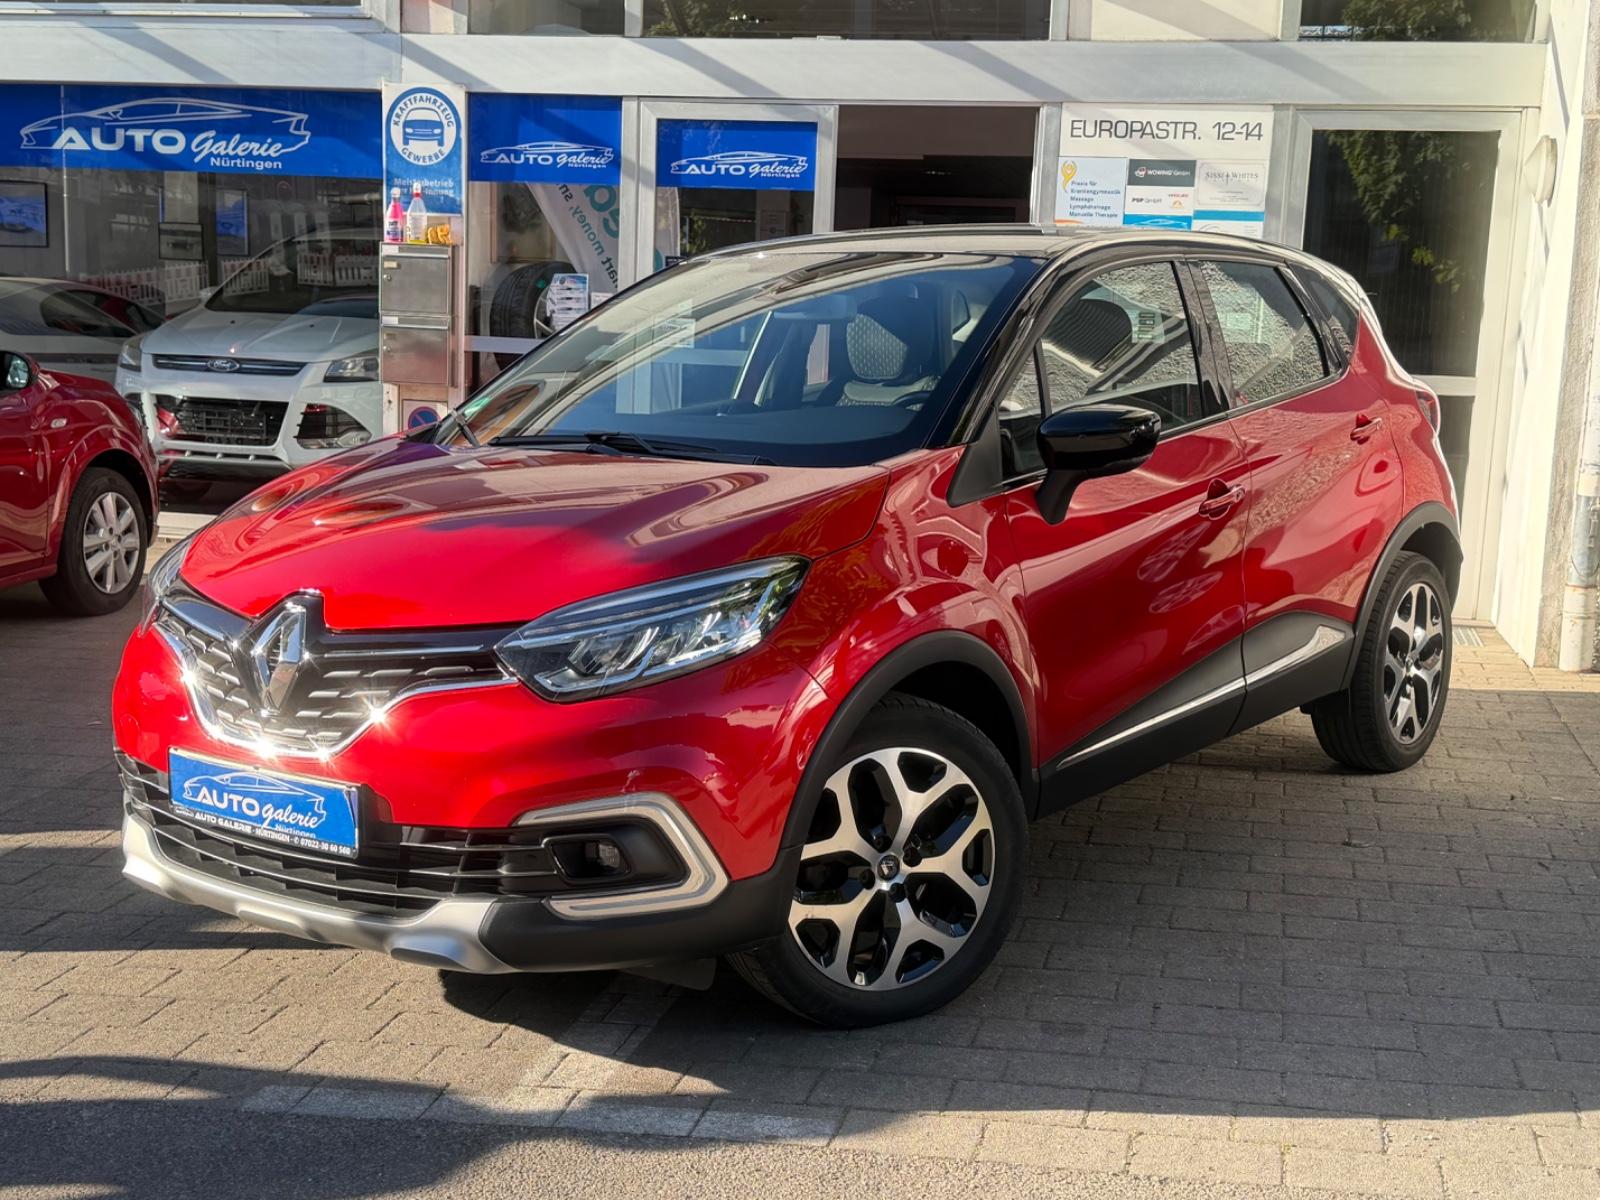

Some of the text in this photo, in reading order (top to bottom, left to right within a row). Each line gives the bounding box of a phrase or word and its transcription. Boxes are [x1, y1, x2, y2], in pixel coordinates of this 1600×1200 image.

[393, 94, 454, 128] KRAFTFAHRZEUG
[51, 127, 187, 155] AUTO
[1070, 119, 1263, 142] EUROPASTR. 12-14
[210, 157, 282, 170] Nürtingen
[401, 147, 446, 163] GEWERBE
[495, 153, 554, 165] AUTO
[685, 164, 746, 176] AUTO
[196, 786, 260, 817] AUTO
[195, 812, 216, 823] AUTO
[218, 818, 252, 834] GALERIE
